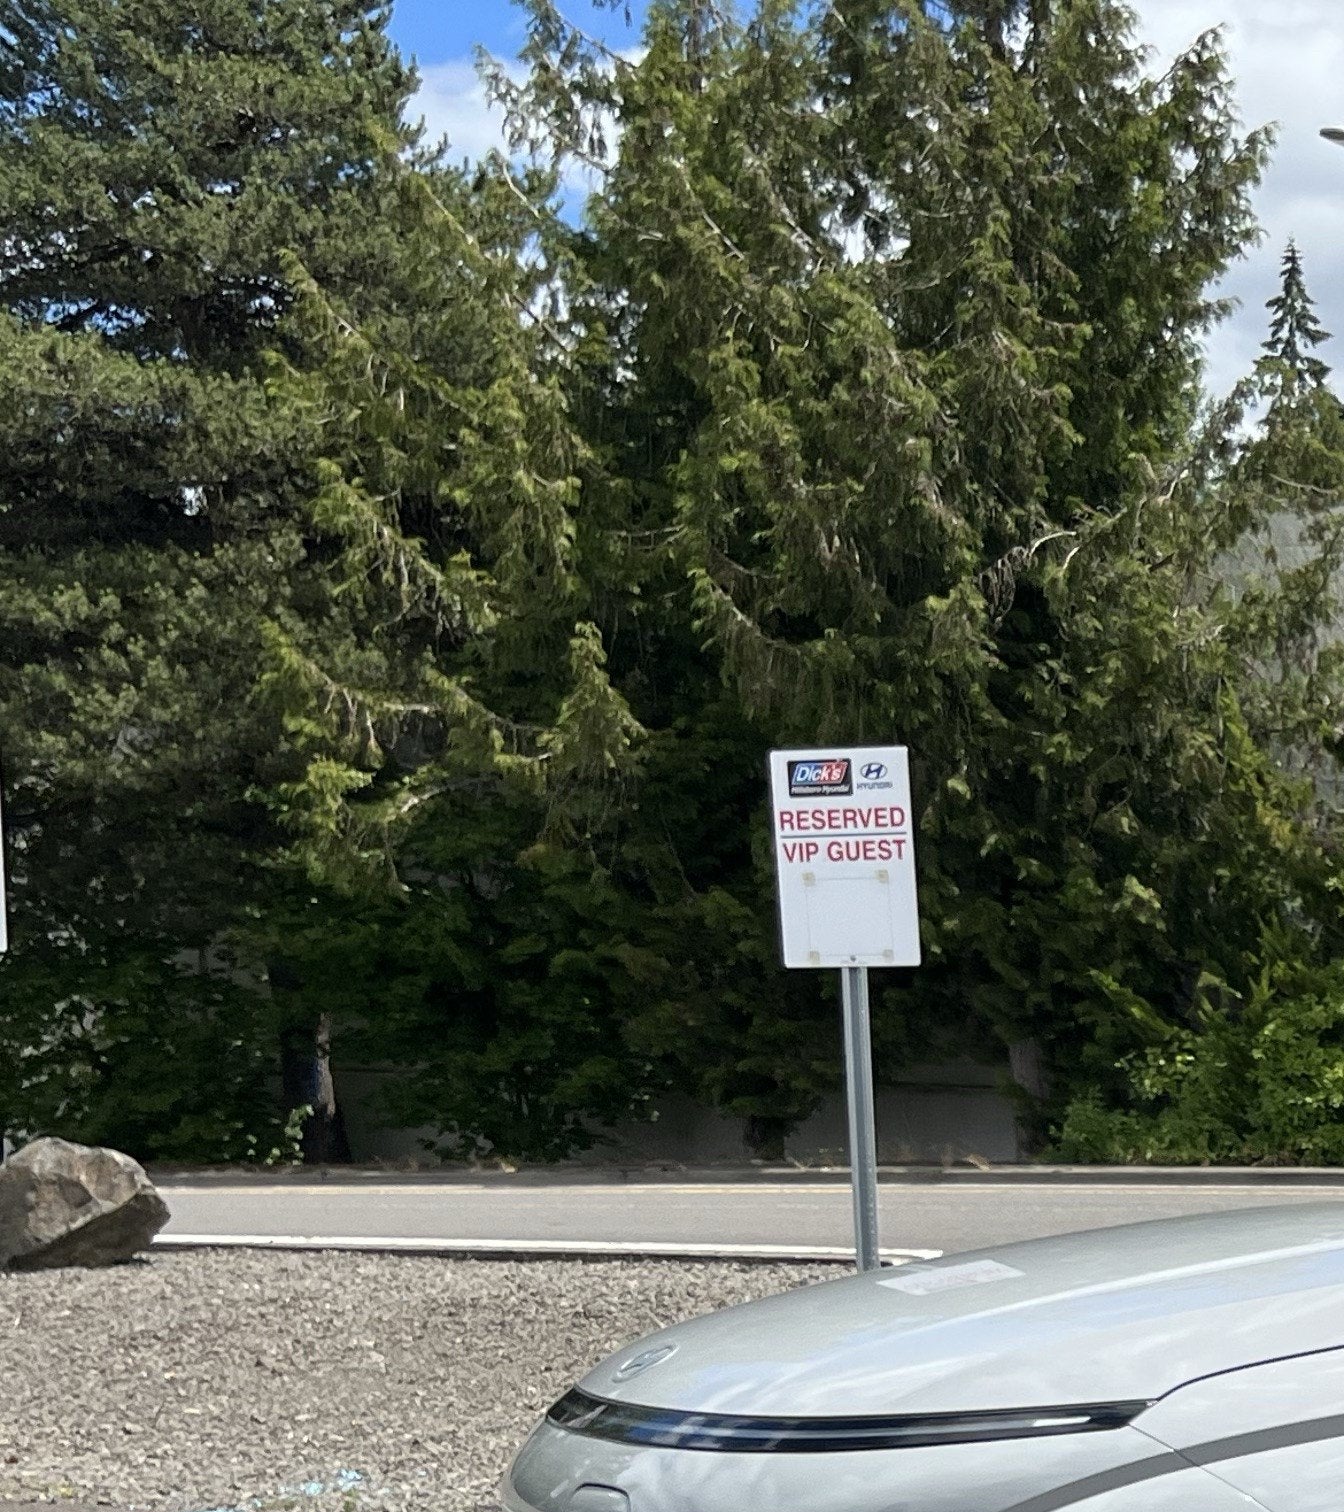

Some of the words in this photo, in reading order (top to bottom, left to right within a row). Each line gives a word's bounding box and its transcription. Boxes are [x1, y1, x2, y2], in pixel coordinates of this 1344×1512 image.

[779, 807, 905, 831] RESERVED
[783, 842, 819, 863] VIP
[827, 839, 907, 862] GUEST
